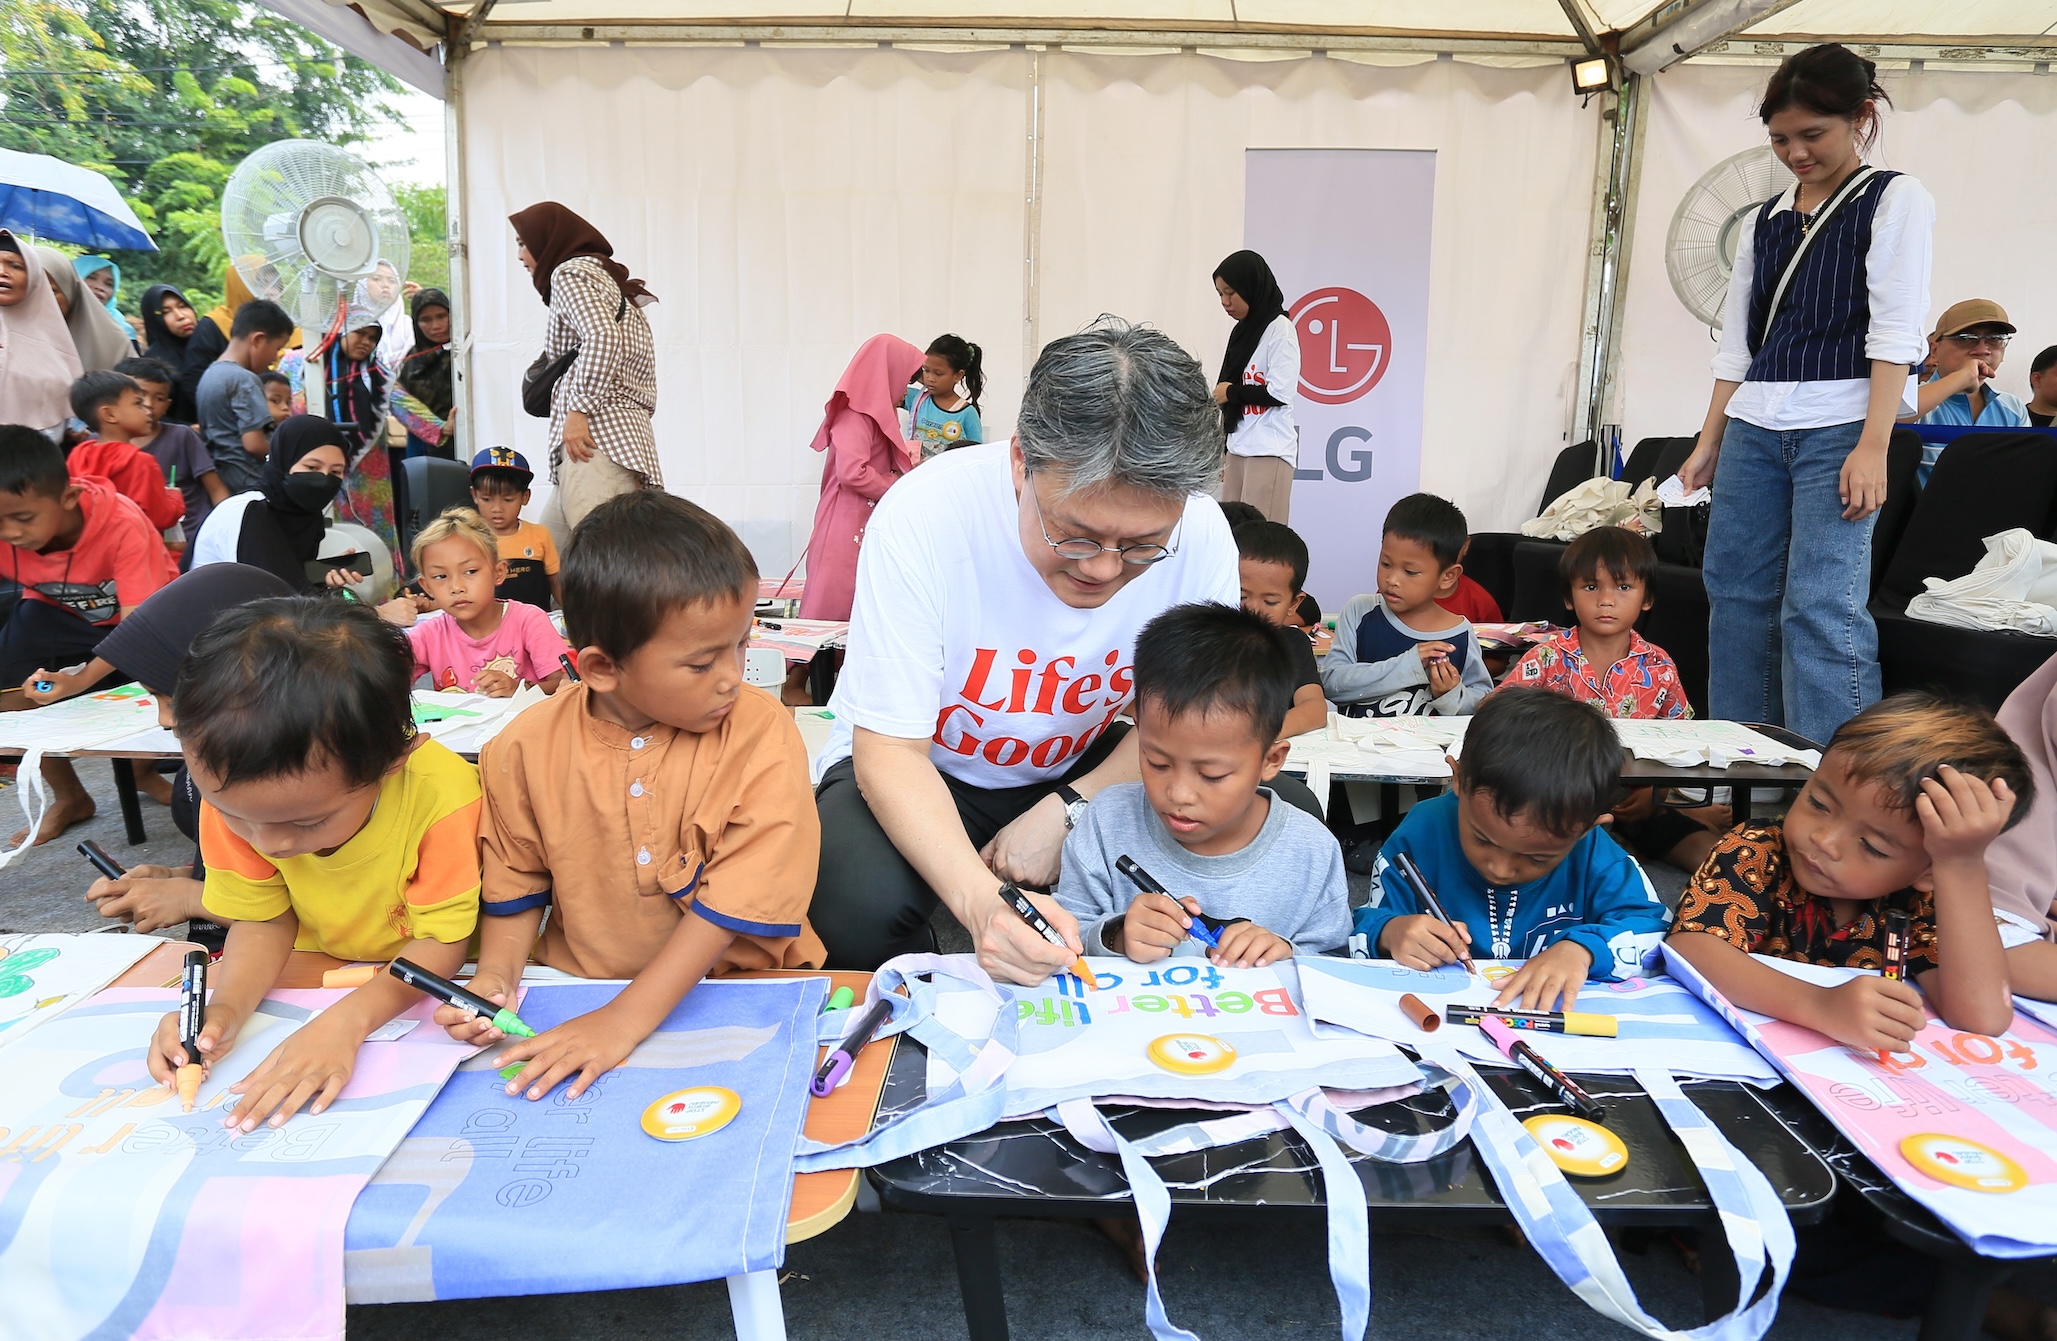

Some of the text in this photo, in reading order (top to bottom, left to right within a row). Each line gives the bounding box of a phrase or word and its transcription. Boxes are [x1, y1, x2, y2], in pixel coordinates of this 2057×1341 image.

[1293, 425, 1374, 482] LG
[510, 566, 531, 574] HERO
[959, 648, 1135, 716] Life's
[932, 704, 1122, 768] Good
[1141, 965, 1225, 992] for
[1107, 987, 1299, 1020] Better
[1931, 1033, 2039, 1071] for
[1829, 1076, 1960, 1118] life
[77, 1122, 341, 1162] Better
[440, 1107, 521, 1162] all
[496, 1136, 596, 1208] life
